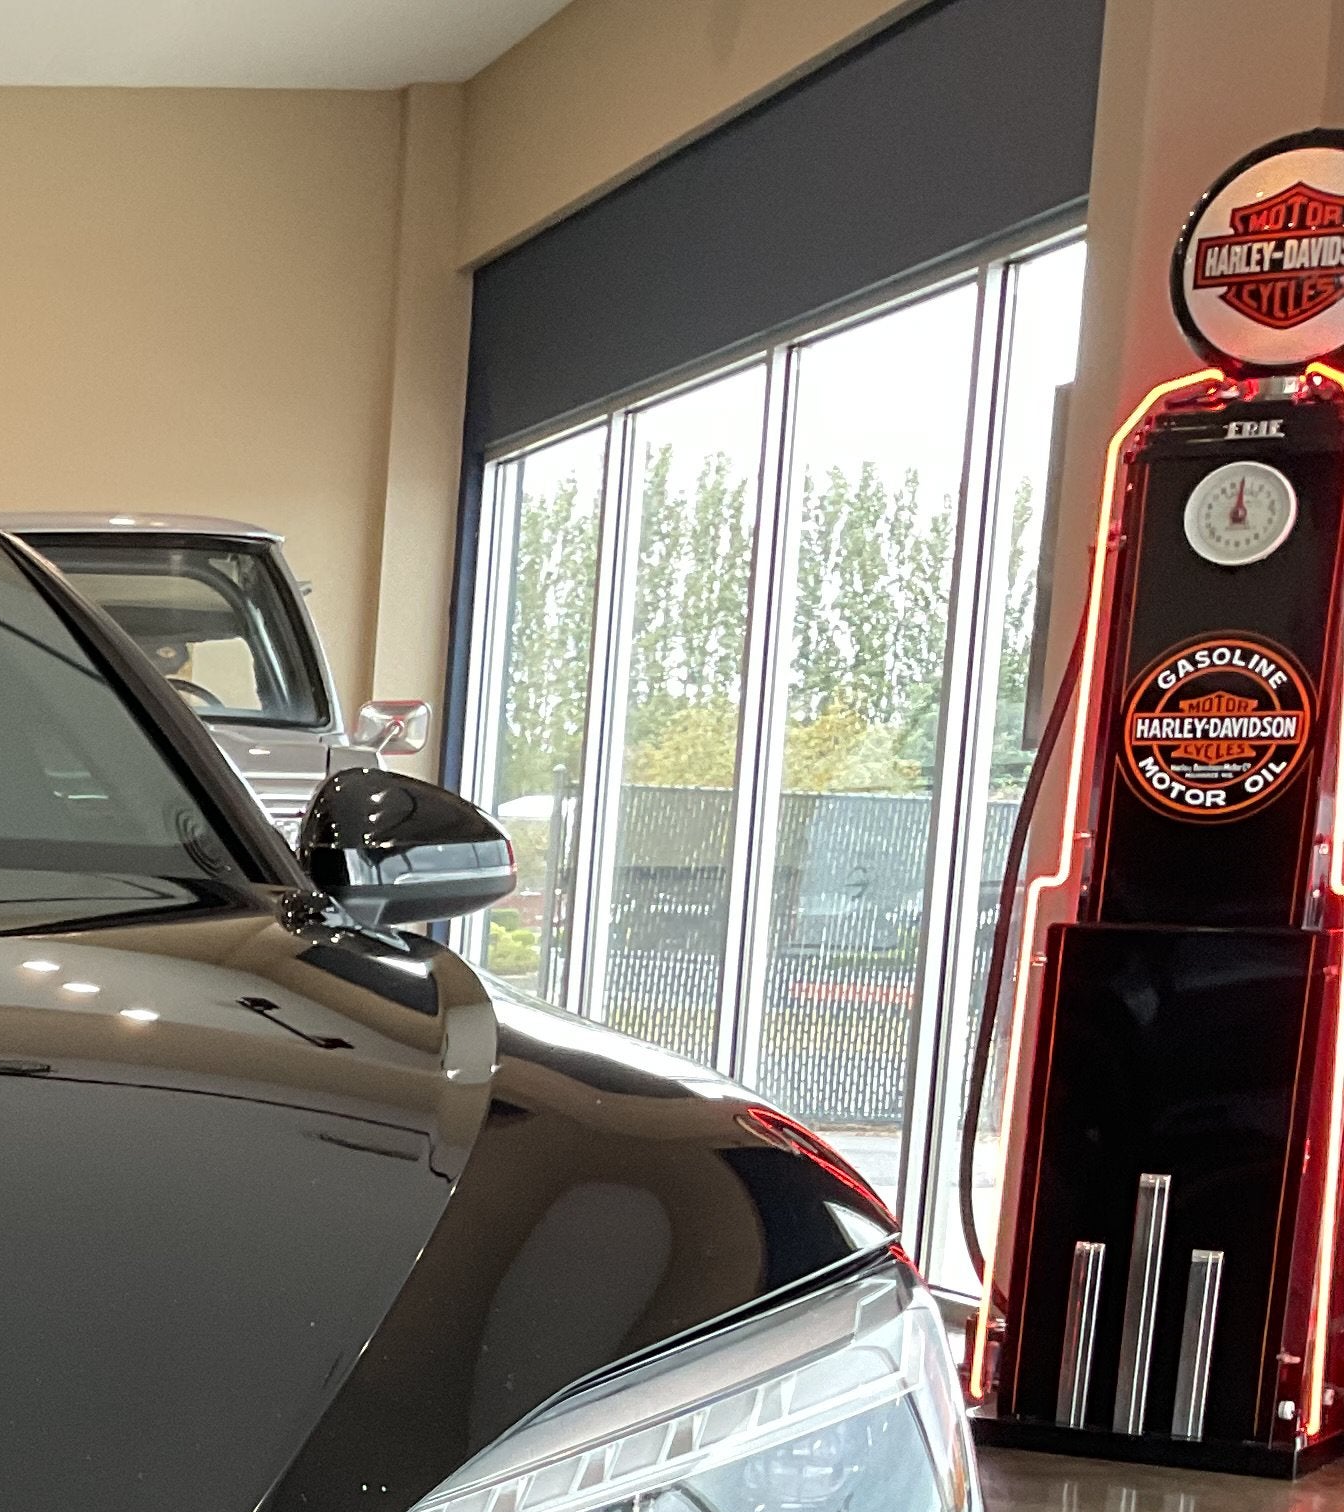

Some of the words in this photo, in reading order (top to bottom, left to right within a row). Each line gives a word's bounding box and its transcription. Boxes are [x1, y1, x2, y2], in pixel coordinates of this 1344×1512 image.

[1248, 196, 1343, 232] MOTOR
[1241, 277, 1336, 319] CYCLES
[1225, 419, 1285, 440] ERIE
[1156, 647, 1289, 691] GASOLINE
[1187, 694, 1249, 714] MOTOR
[1135, 716, 1298, 740] HARLEY-DAVIDSON
[1182, 743, 1246, 761] CYCLES
[1138, 756, 1228, 807] MOTOR
[1243, 760, 1288, 794] OIL
